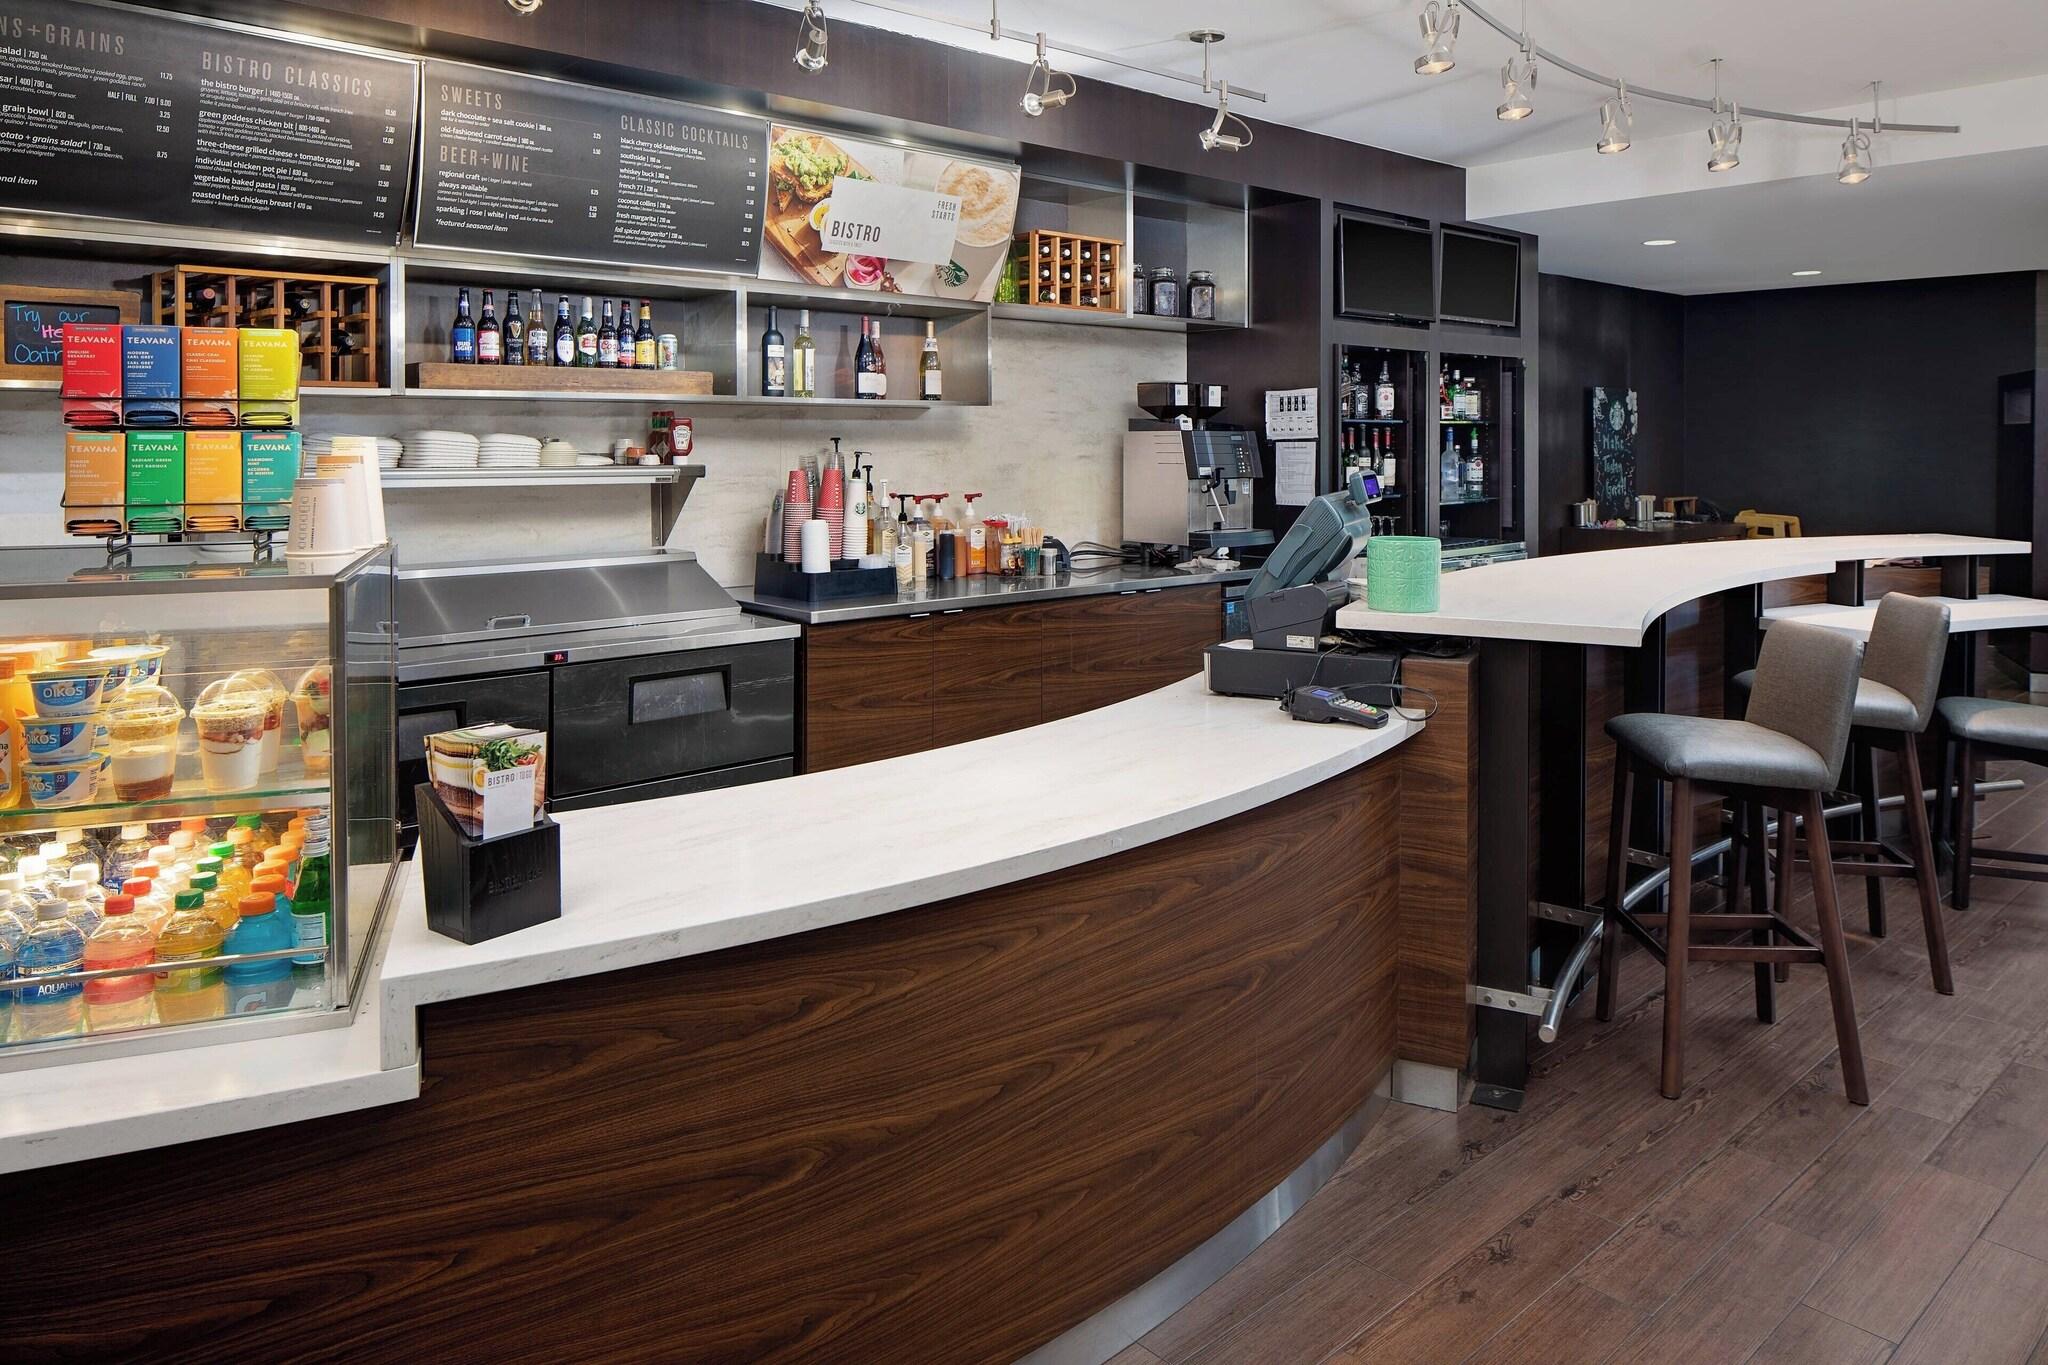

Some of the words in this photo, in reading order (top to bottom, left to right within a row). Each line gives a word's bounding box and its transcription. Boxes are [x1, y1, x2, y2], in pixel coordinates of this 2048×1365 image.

[202, 51, 272, 81] BISTRO
[284, 66, 372, 98] CLASSICS
[200, 78, 214, 86] the
[216, 80, 238, 90] bistro
[238, 84, 264, 96] burger
[107, 90, 120, 99] HALF
[124, 93, 137, 102] FULL
[440, 84, 502, 110] SWEETS
[2, 104, 26, 112] grain
[27, 106, 49, 116] bowl
[55, 110, 66, 119] 820
[159, 110, 171, 119] 3.25
[199, 110, 221, 118] green
[222, 113, 254, 124] goddess
[254, 118, 282, 128] chicken
[440, 108, 456, 117] dark
[456, 112, 486, 122] chocolate
[515, 121, 536, 130] cookie
[156, 125, 170, 133] 12.50
[440, 126, 483, 138] old-fashioned
[484, 132, 502, 141] carrot
[620, 114, 674, 138] CLASSIC
[682, 125, 748, 150] COCKTAILS
[32, 136, 58, 145] grains
[620, 136, 636, 145] black
[636, 140, 652, 148] cherry
[654, 142, 688, 153] old-fashioned
[197, 138, 245, 152] three-cheese
[245, 146, 268, 154] grilled
[268, 149, 292, 158] cheese
[300, 152, 324, 162] tomato
[325, 157, 342, 166] soup
[620, 153, 646, 162] southside
[195, 156, 233, 168] individual
[233, 160, 261, 172] chicken
[276, 166, 288, 174] pie
[438, 170, 464, 178] regional
[620, 168, 641, 177] whiskey
[18, 176, 38, 186] item
[194, 174, 231, 184] vegetable
[232, 177, 255, 187] baked
[438, 181, 460, 190] always
[460, 184, 488, 192] available
[618, 182, 636, 190] french
[192, 191, 220, 200] roasted
[222, 194, 240, 202] herb
[240, 196, 268, 205] chicken
[269, 199, 292, 208] breast
[618, 198, 640, 206] coconut
[436, 206, 466, 216] sparkling
[487, 210, 504, 218] white
[937, 200, 957, 212] FRESH
[616, 212, 630, 220] fresh
[630, 214, 656, 222] margarita
[930, 210, 956, 222] STARTS
[466, 222, 494, 231] seasonal
[624, 228, 640, 236] spiced
[831, 220, 881, 242] BISTRO
[10, 304, 40, 332] Try
[58, 310, 90, 322] our
[67, 336, 116, 344] TEAVANA
[126, 336, 174, 345] TEAVANA
[186, 338, 232, 346] TEAVANA
[243, 340, 288, 348] TEAVANA
[132, 444, 178, 452] TEAVANA
[43, 686, 82, 698] OIKOS
[488, 773, 515, 786] BISTRO
